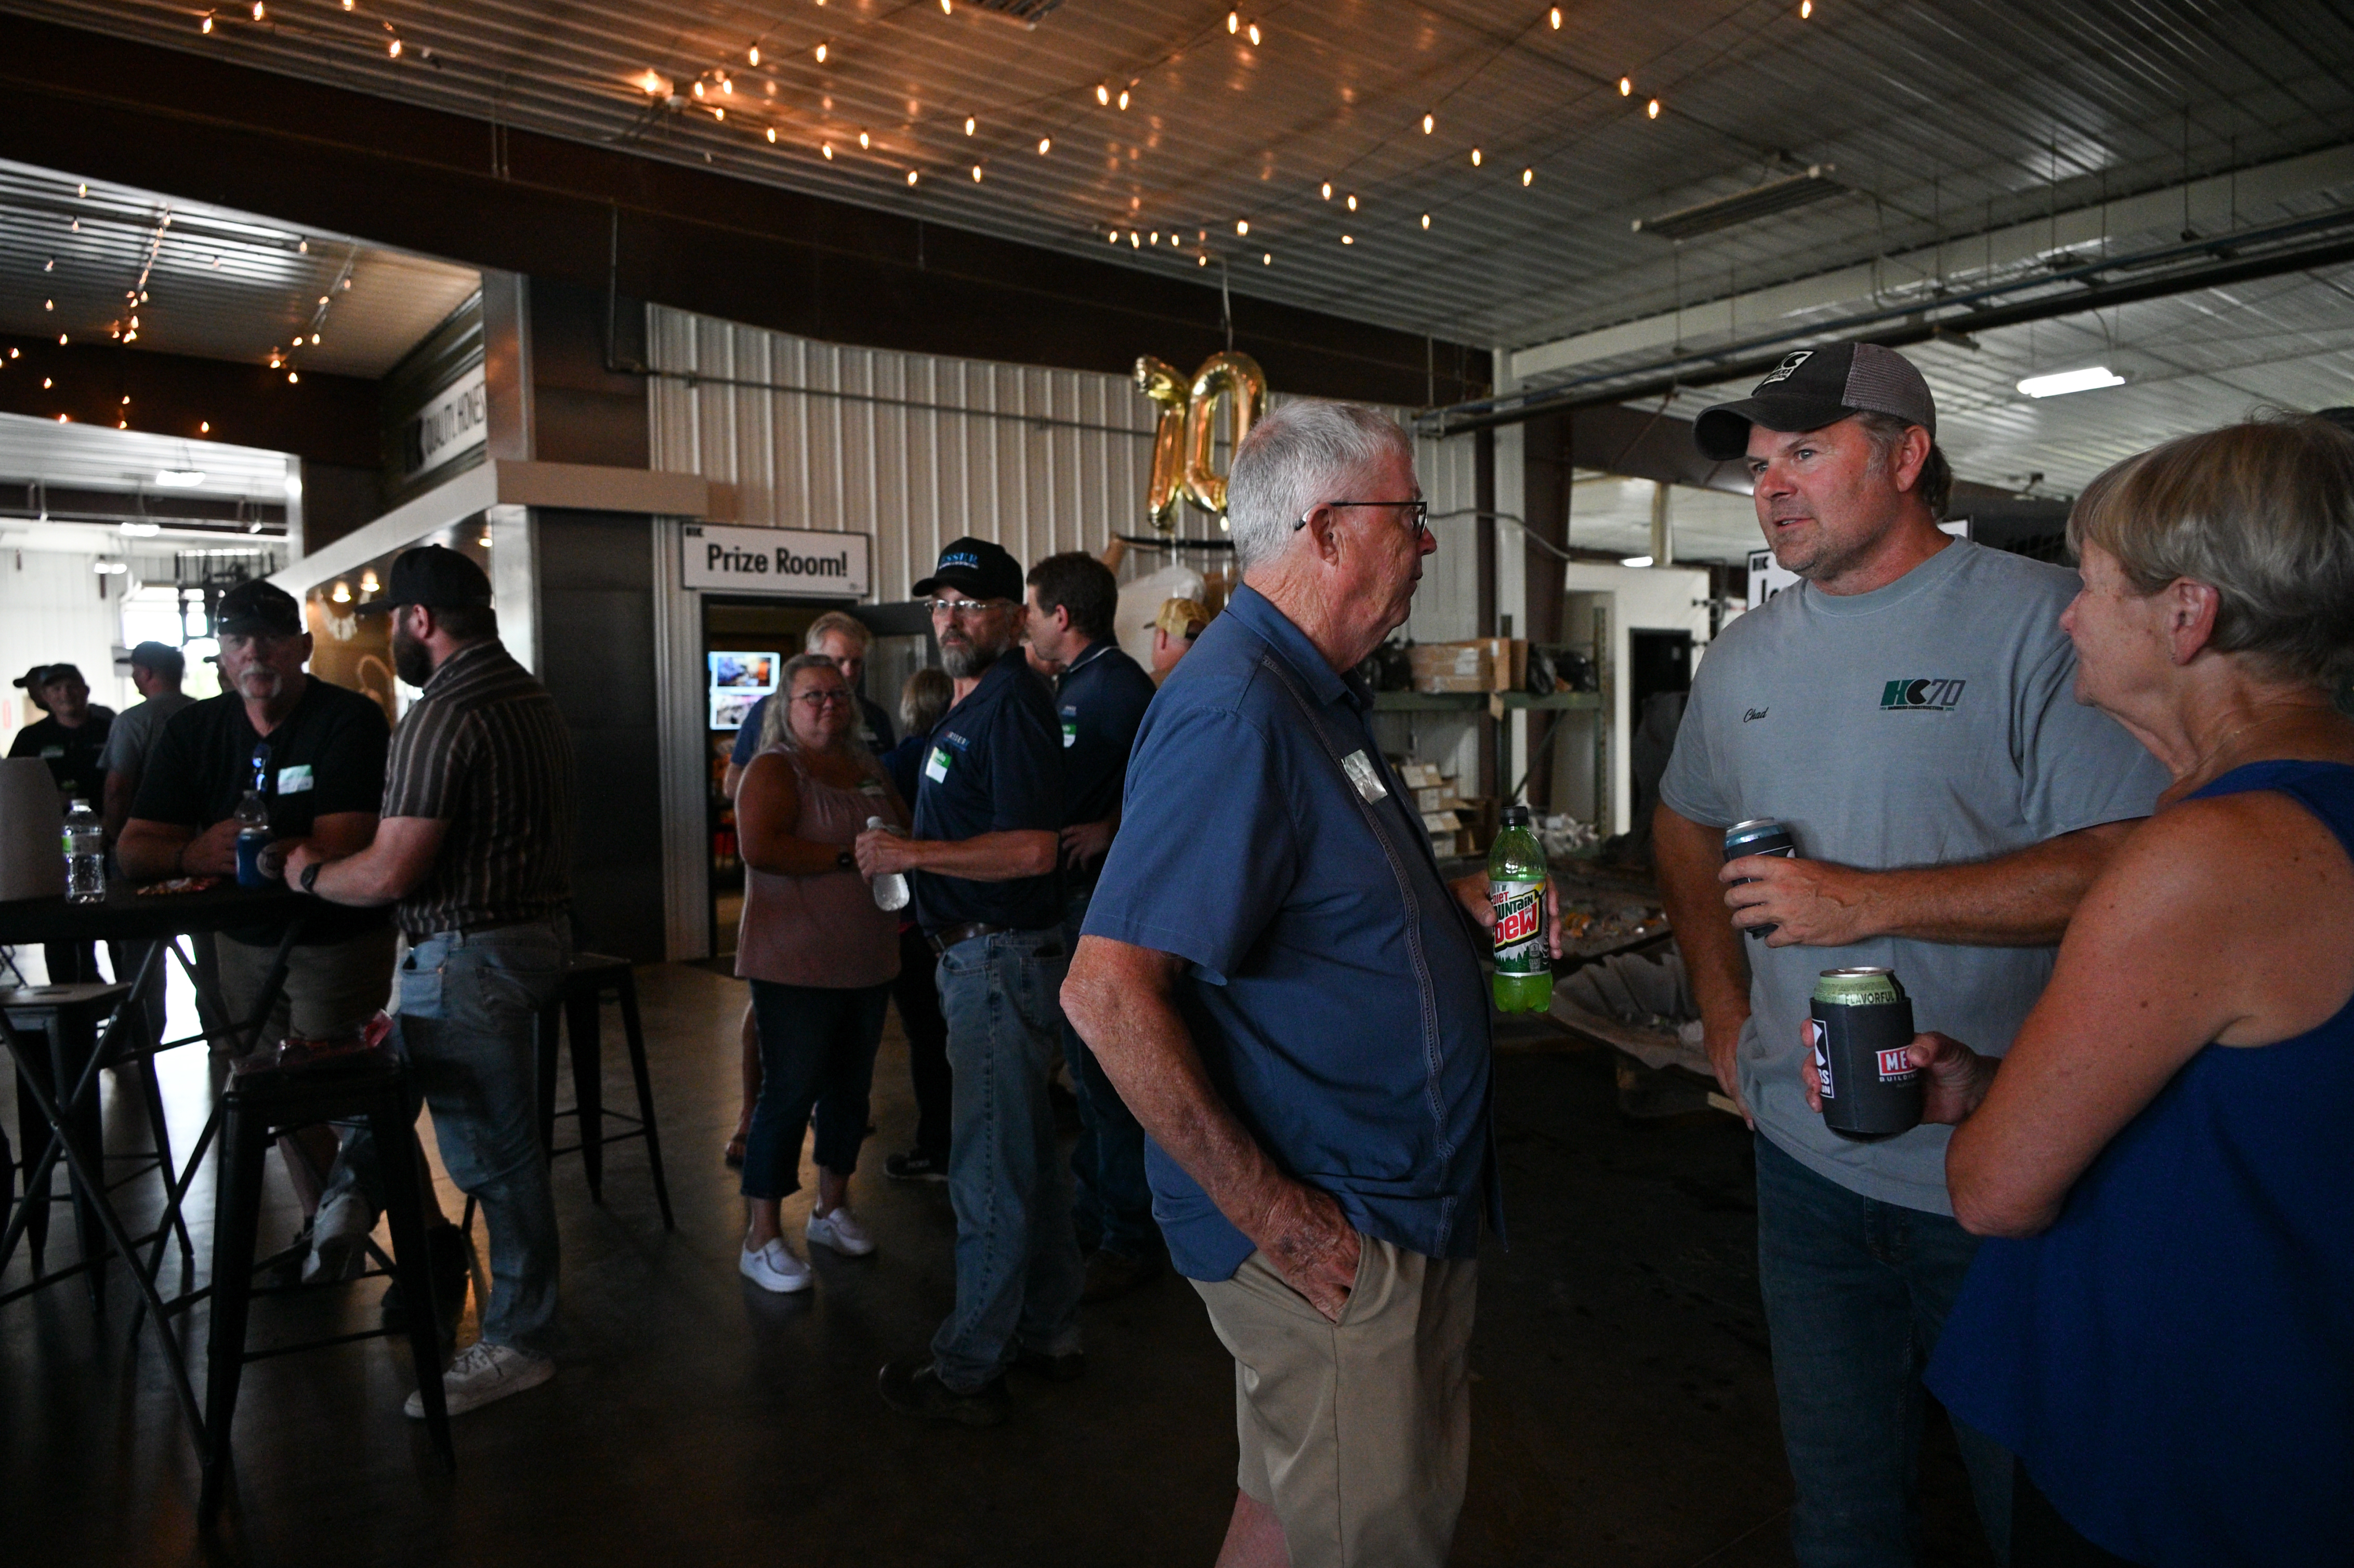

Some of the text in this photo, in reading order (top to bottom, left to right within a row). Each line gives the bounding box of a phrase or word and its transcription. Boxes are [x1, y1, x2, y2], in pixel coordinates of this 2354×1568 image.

[707, 544, 847, 577] Prize Room!
[1743, 707, 1769, 723] Chad
[1845, 991, 1895, 1005] FLAVORFUL
